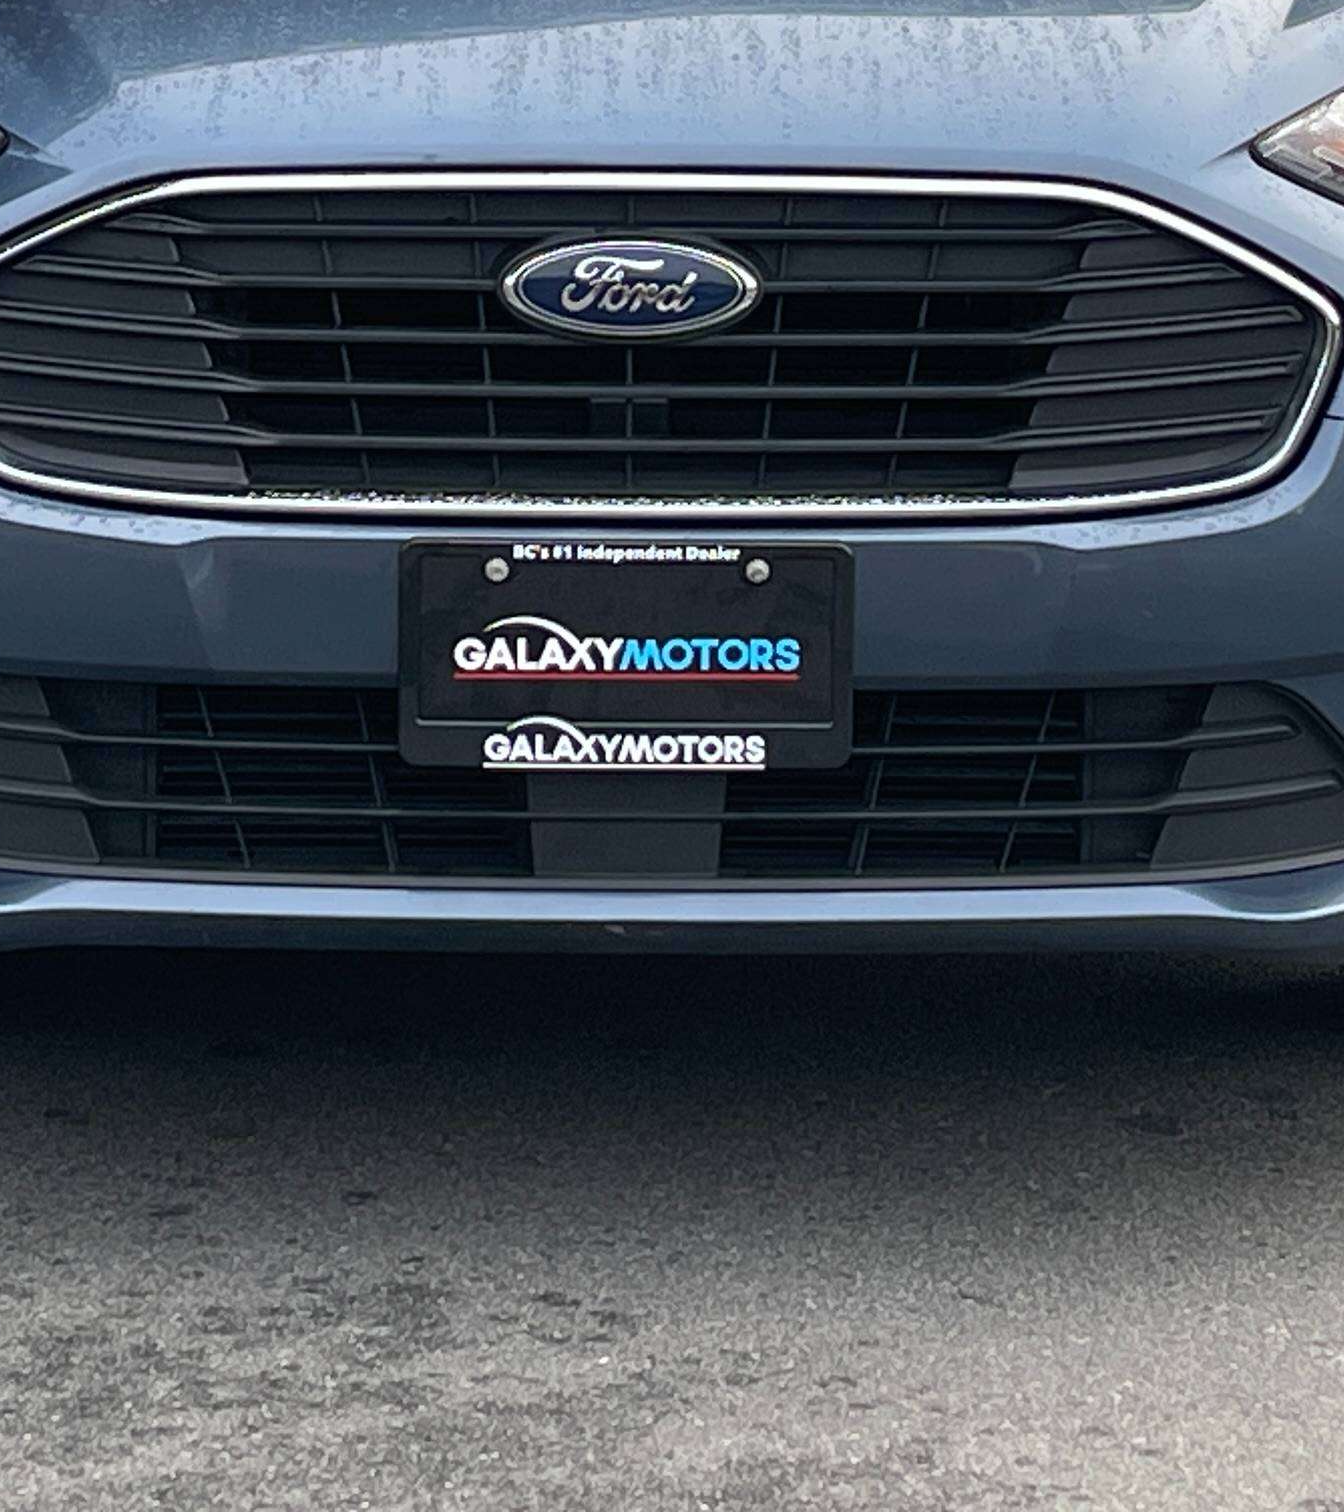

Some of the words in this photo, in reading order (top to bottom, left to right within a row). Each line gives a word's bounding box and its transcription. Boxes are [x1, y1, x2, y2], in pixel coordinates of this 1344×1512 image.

[561, 255, 698, 312] Ford
[513, 544, 550, 560] BC's
[553, 545, 573, 560] #1
[577, 544, 684, 564] Independent
[686, 545, 740, 561] Dealer
